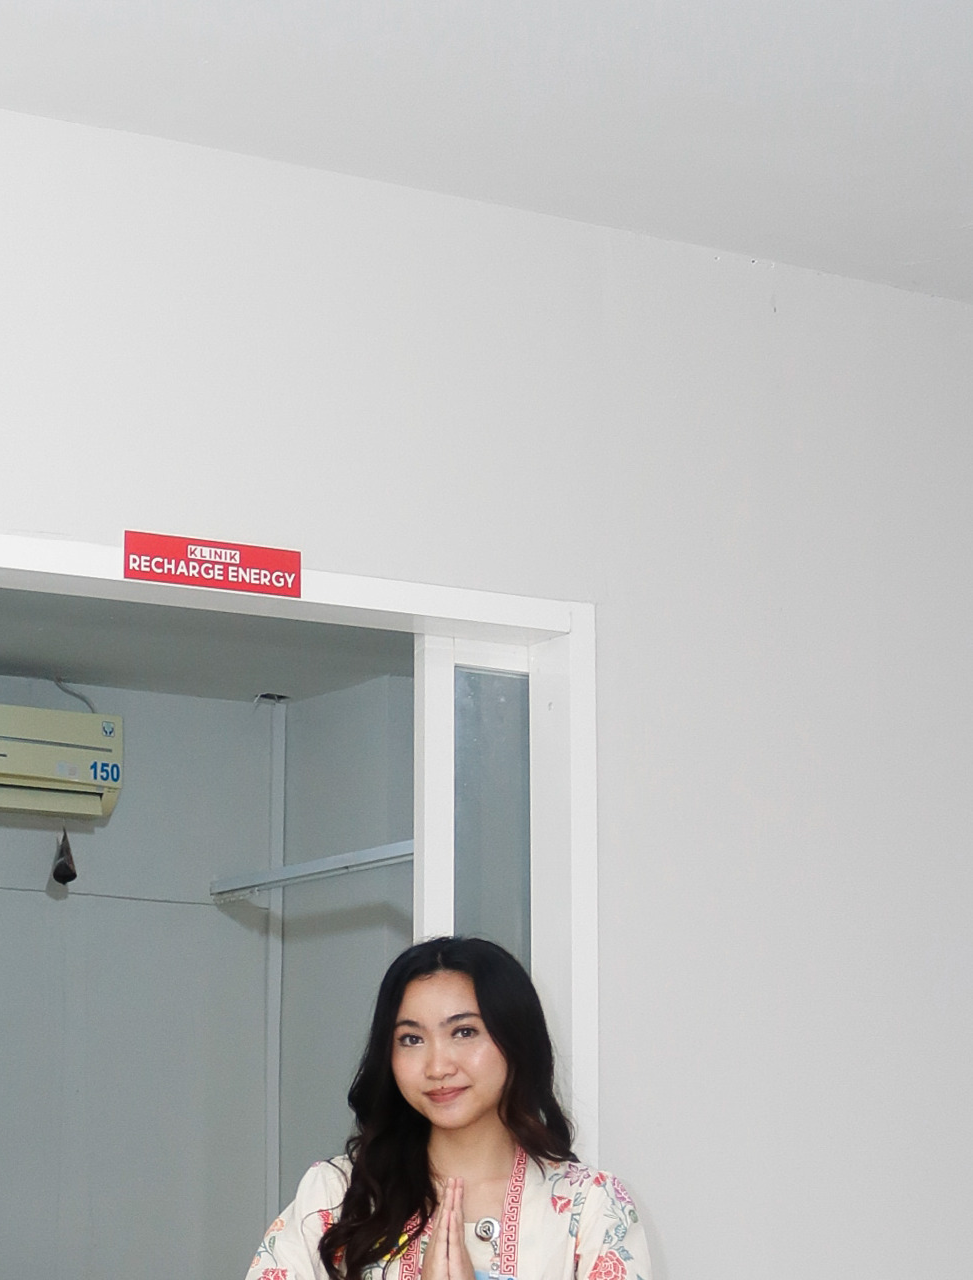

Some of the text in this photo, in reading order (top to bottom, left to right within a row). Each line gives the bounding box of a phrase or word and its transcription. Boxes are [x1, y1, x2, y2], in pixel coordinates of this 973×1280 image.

[189, 547, 238, 562] KLINIK
[129, 554, 296, 588] RECHARGE ENERGY
[89, 761, 120, 782] 150
